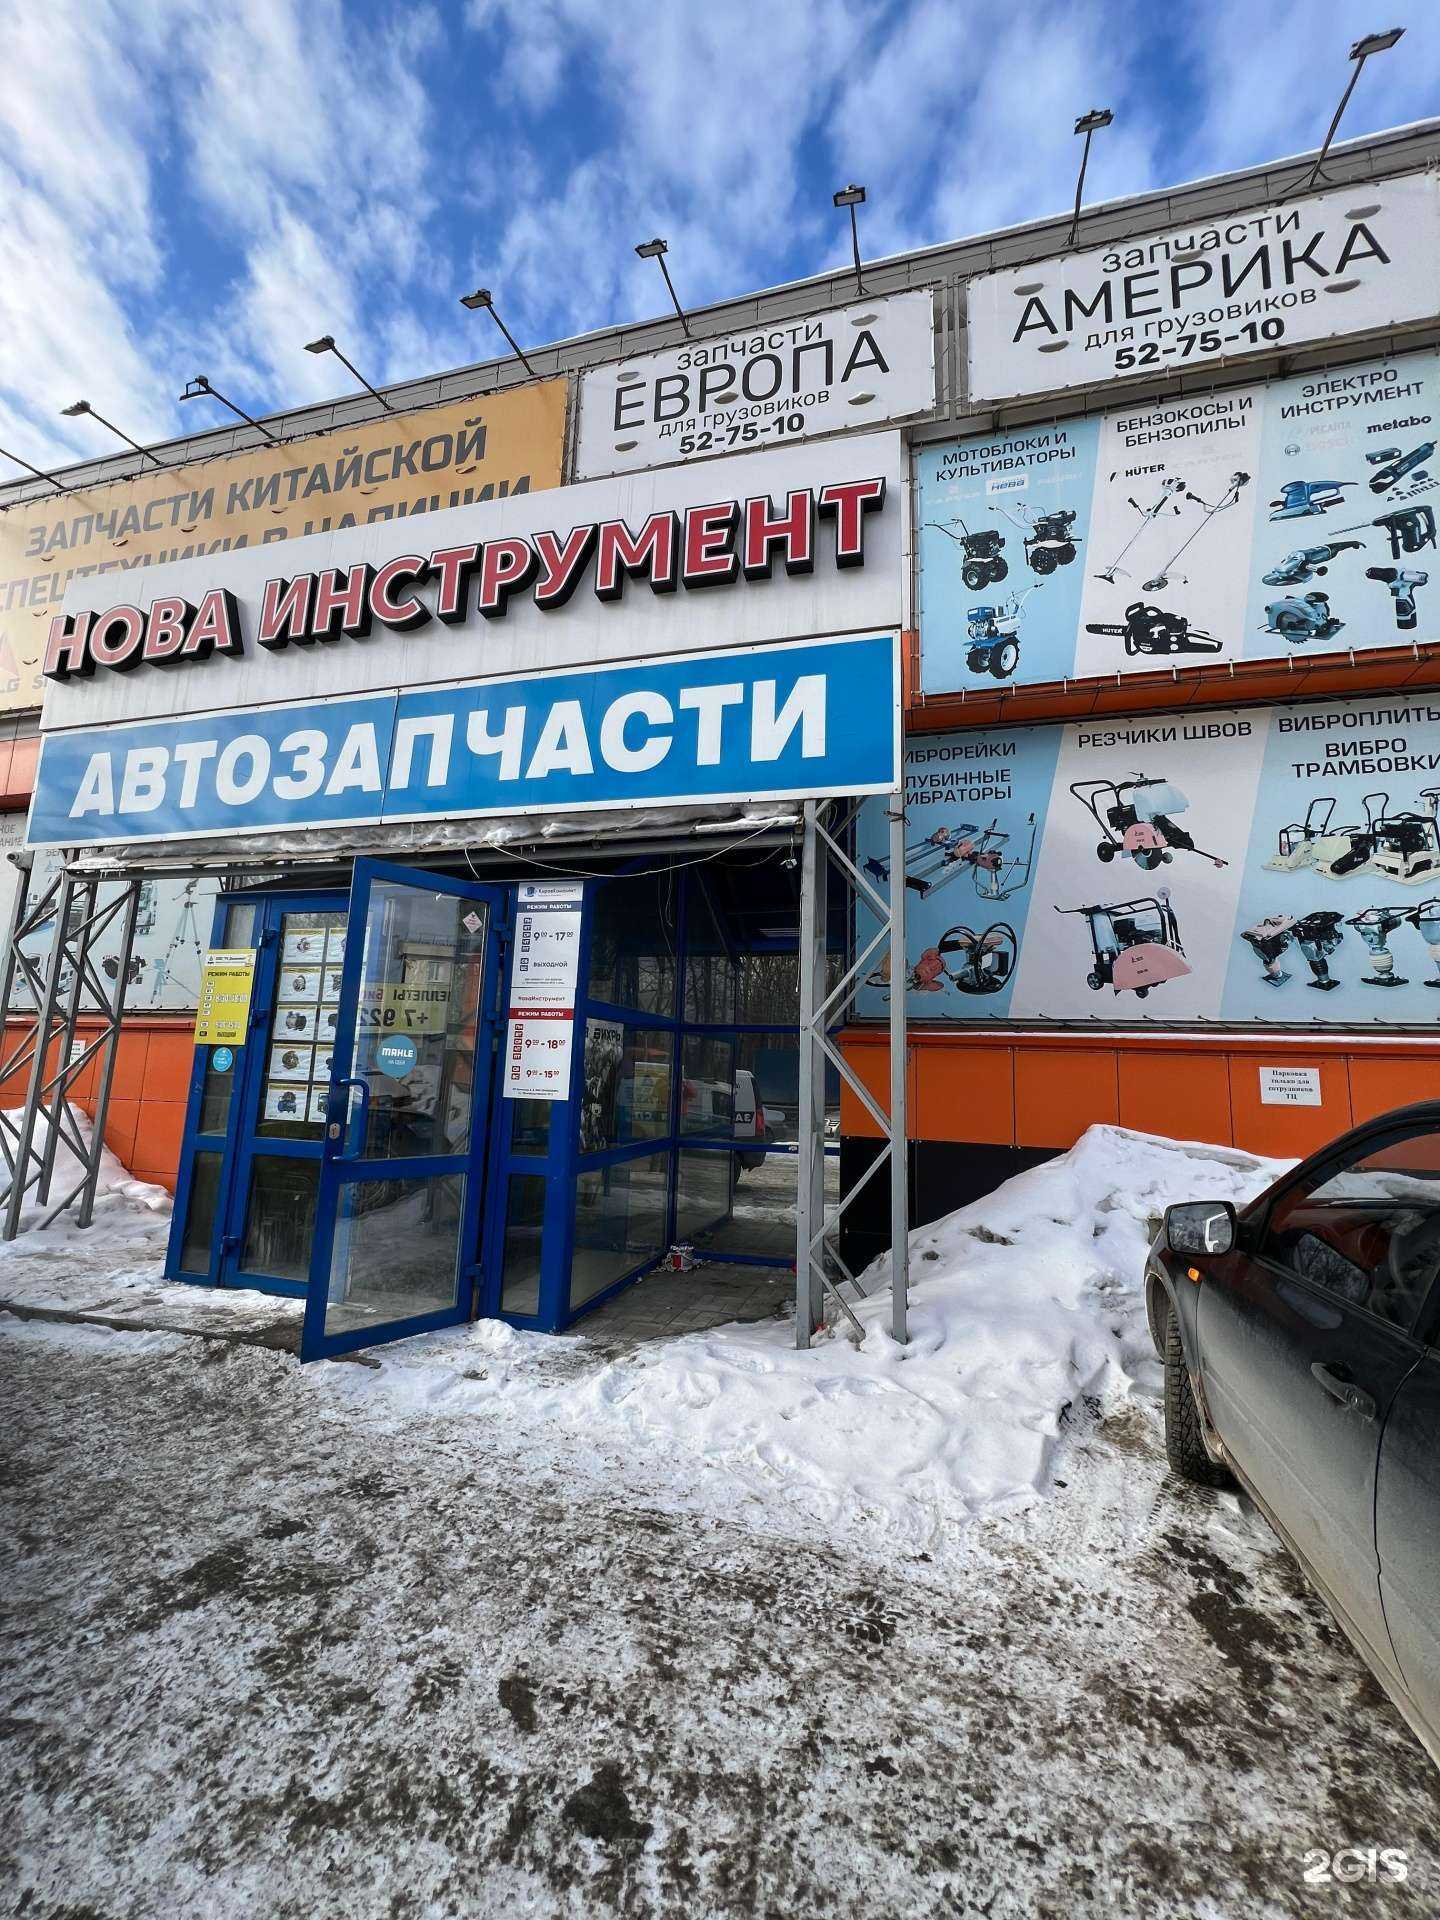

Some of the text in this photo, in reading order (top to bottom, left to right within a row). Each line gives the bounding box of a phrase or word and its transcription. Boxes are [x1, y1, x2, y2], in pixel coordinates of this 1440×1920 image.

[1102, 209, 1300, 274] запчасти
[1012, 223, 1391, 343] АМЕРИКА
[1085, 288, 1317, 352] для грузовиков
[677, 321, 823, 371] запчасти
[1115, 317, 1285, 369] 52-75-10
[614, 330, 890, 431] ЕВРОПА
[1302, 369, 1398, 398] ЭЛЕКТРО
[659, 390, 830, 439] для грузовиков
[1117, 397, 1253, 433] БЕНЗОКОСЫ И
[1281, 381, 1424, 419] ИНСТРУМЕНТ
[679, 412, 805, 454] 52-75-10
[1125, 415, 1246, 447] БЕНЗОПИЛЫ
[1367, 415, 1432, 434] metabo
[936, 446, 1076, 482] КУЛЬТИВАТОРЫ
[943, 432, 1067, 465] МОТОБЛОКИ И
[25, 416, 487, 557] ЗАПЧАСТИ КИТАЙСКОЙ
[1125, 463, 1165, 477] HÜTER
[42, 477, 886, 680] НОВА ИНСТРУМЕНТ
[68, 674, 827, 818] АВТОЗАПЧАСТИ
[1078, 721, 1252, 748] РЕЗЧИКИ ШВОВ
[1325, 738, 1407, 758] ВИБРО
[905, 742, 1016, 764] ИБРОРЕЙКИ
[1292, 755, 1440, 778] ТРАМБОВКИ
[905, 769, 1011, 788] ЛУБИННЫЕ
[905, 786, 1012, 805] ИБРАТОРЫ
[533, 960, 568, 968] ВЫХОДНОЙ
[382, 1047, 414, 1058] MAHLE
